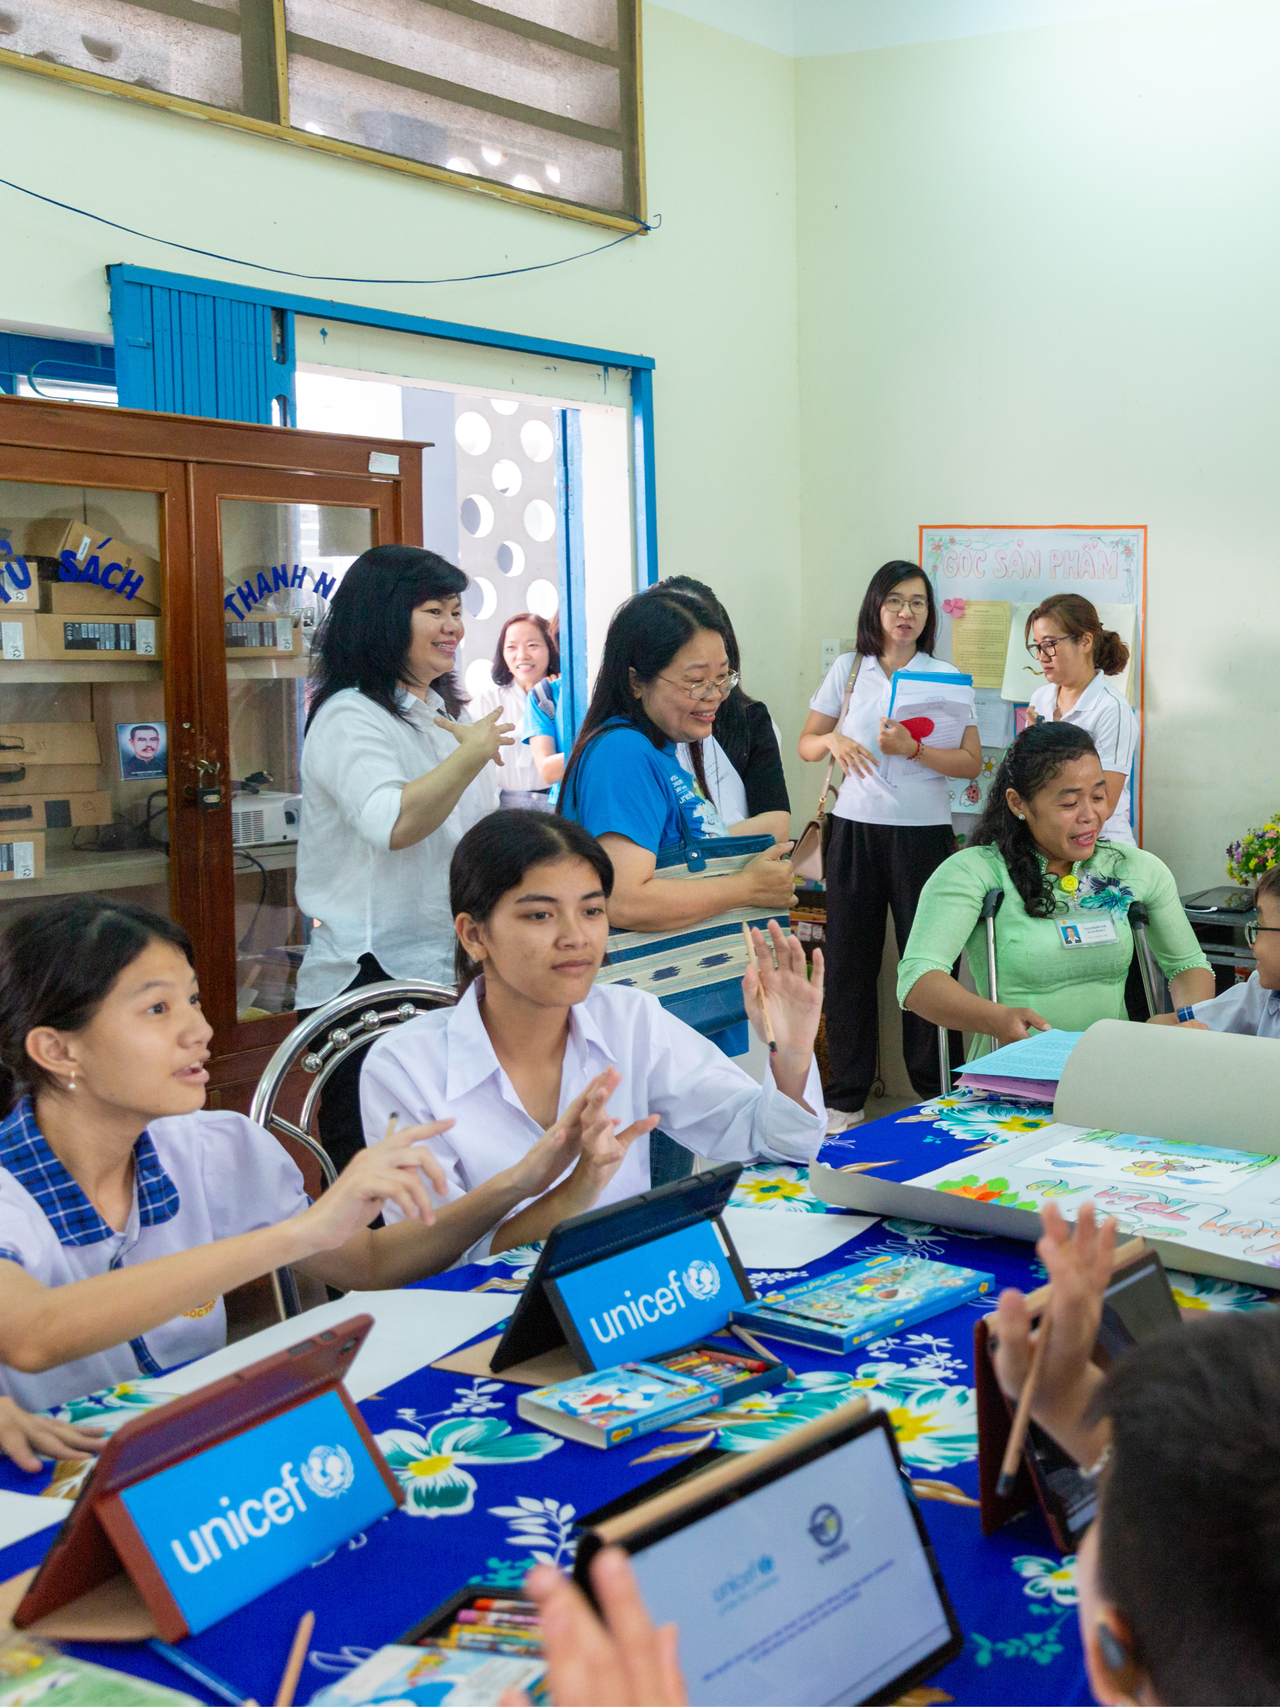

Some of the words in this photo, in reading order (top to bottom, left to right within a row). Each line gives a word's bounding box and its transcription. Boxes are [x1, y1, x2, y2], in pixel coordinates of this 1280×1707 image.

[58, 537, 145, 601] SÁCH
[992, 539, 1041, 580] SẢN
[1050, 540, 1119, 580] PHẨM
[224, 563, 307, 621] THANH
[590, 1269, 687, 1344] unicef
[171, 1461, 308, 1574] unicef
